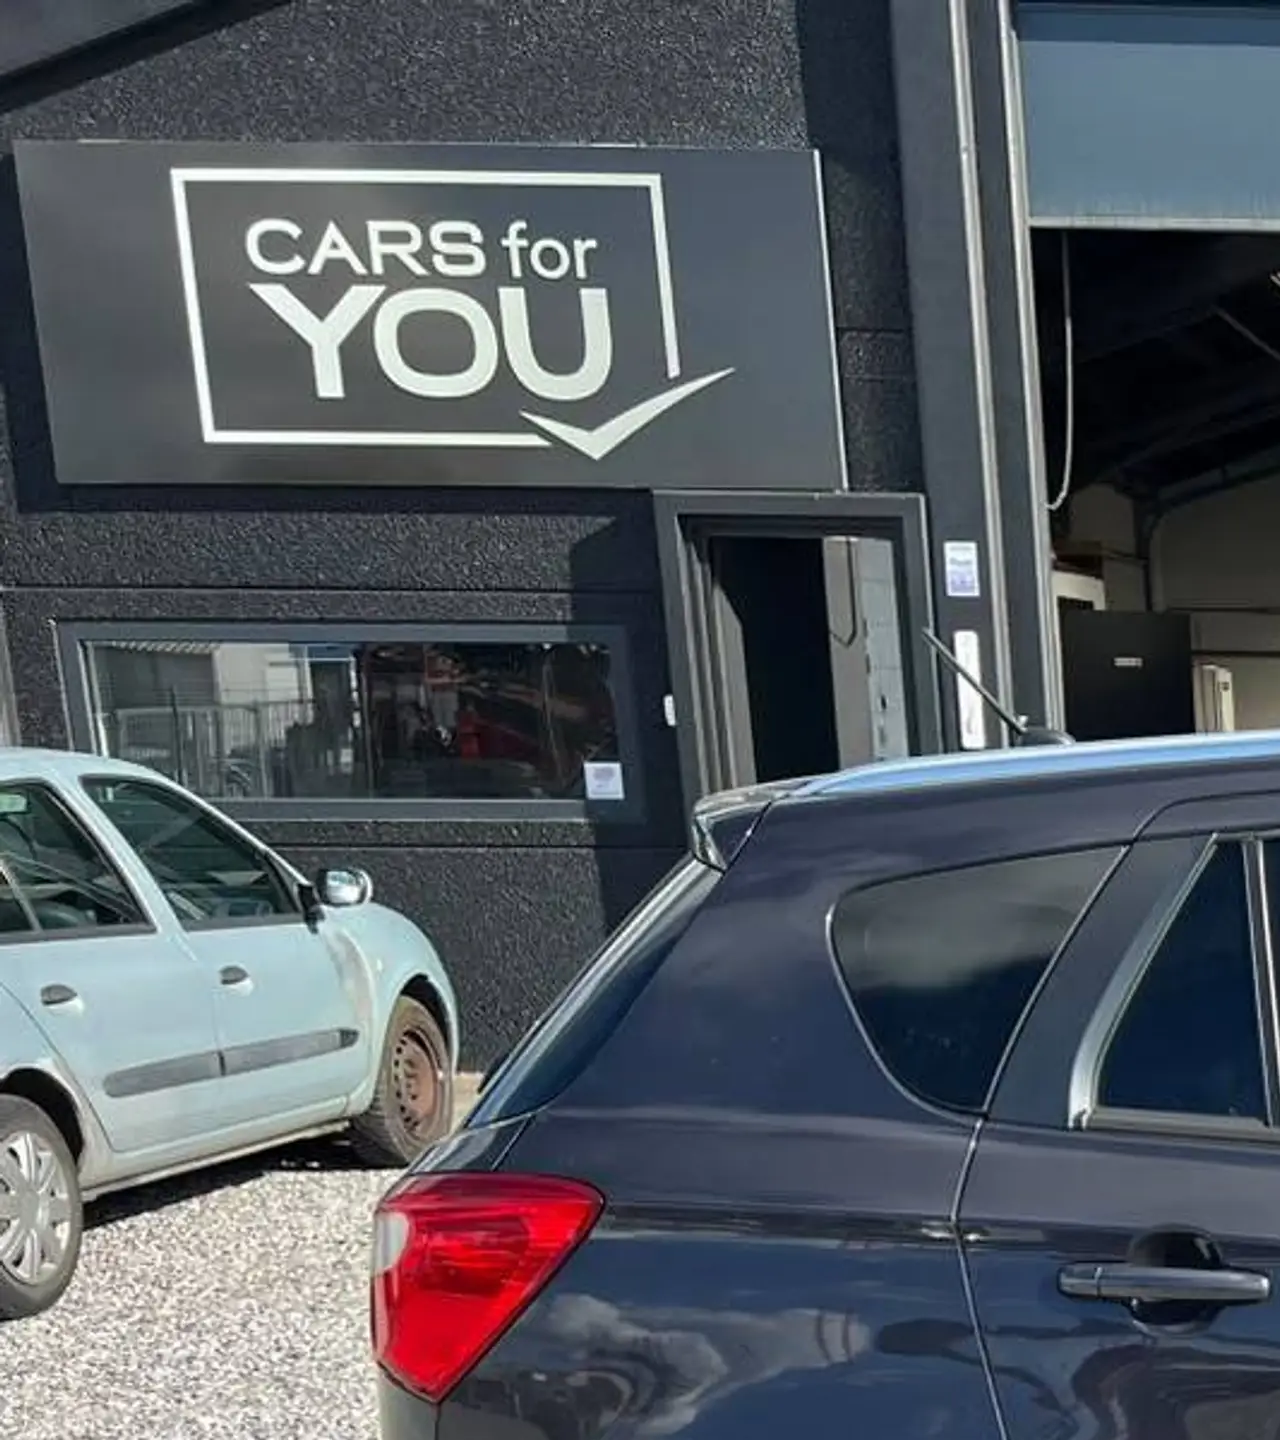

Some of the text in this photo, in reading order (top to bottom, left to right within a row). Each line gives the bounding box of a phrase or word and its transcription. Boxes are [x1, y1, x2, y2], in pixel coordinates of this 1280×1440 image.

[245, 218, 598, 280] CARS for
[248, 282, 613, 401] YOU
